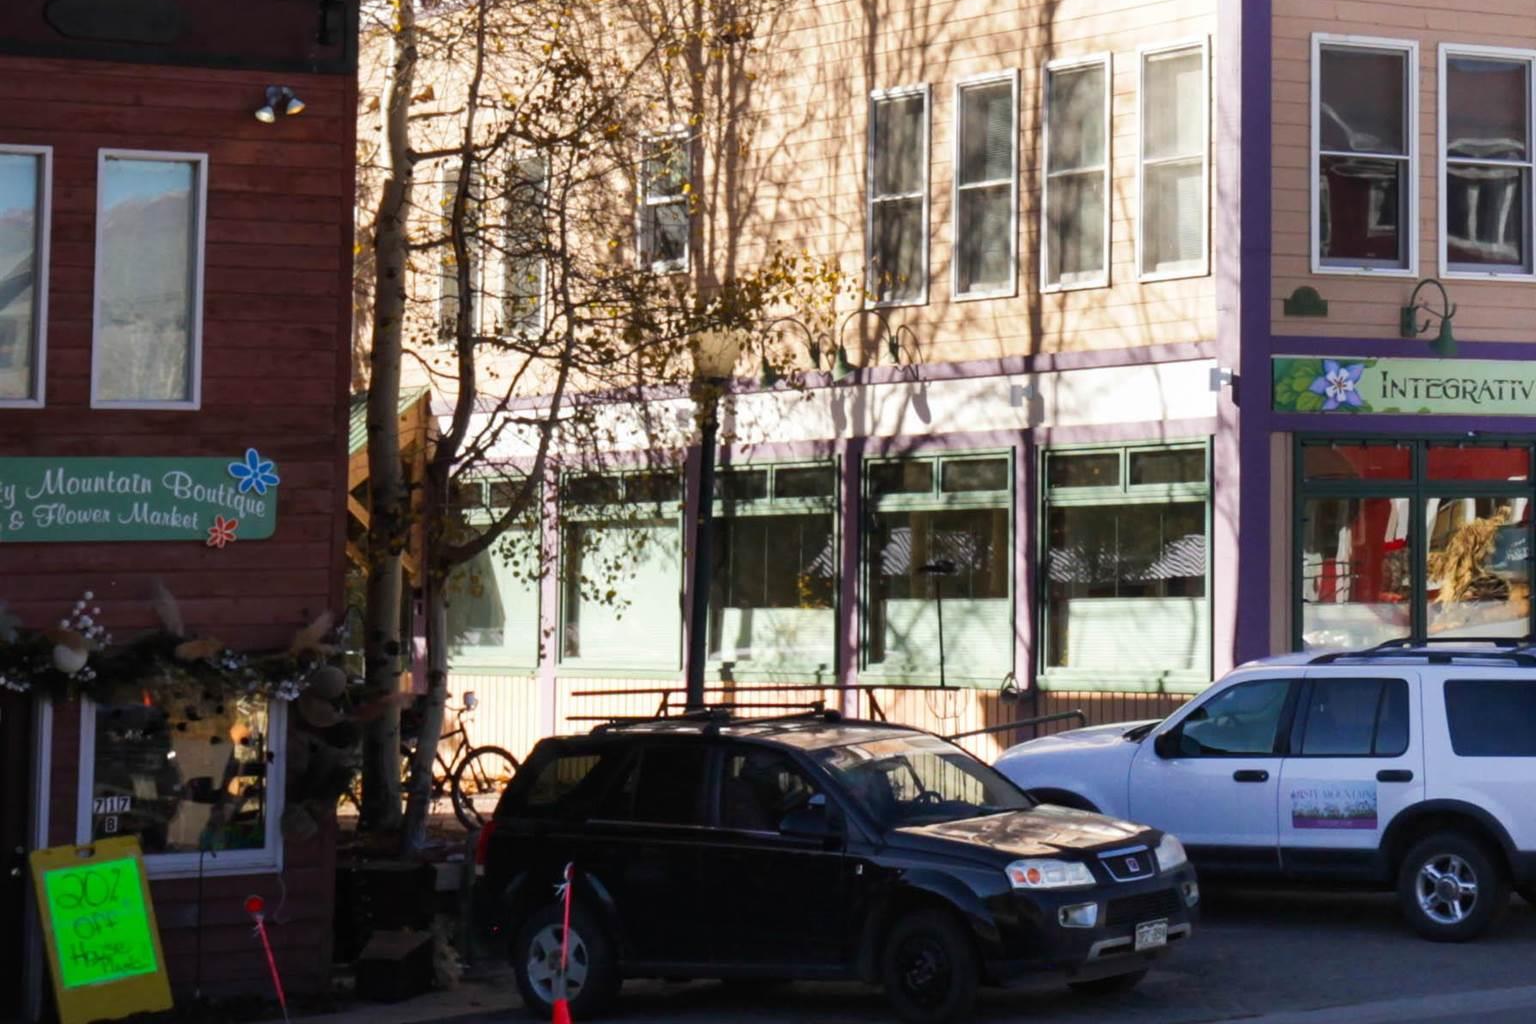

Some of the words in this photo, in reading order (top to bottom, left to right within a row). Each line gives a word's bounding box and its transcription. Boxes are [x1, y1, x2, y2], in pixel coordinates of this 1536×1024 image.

[25, 467, 152, 499] Mountain
[162, 471, 265, 518] Boutique
[9, 510, 24, 530] &
[32, 502, 110, 527] Flower
[118, 502, 199, 530] Market
[95, 796, 130, 813] 717
